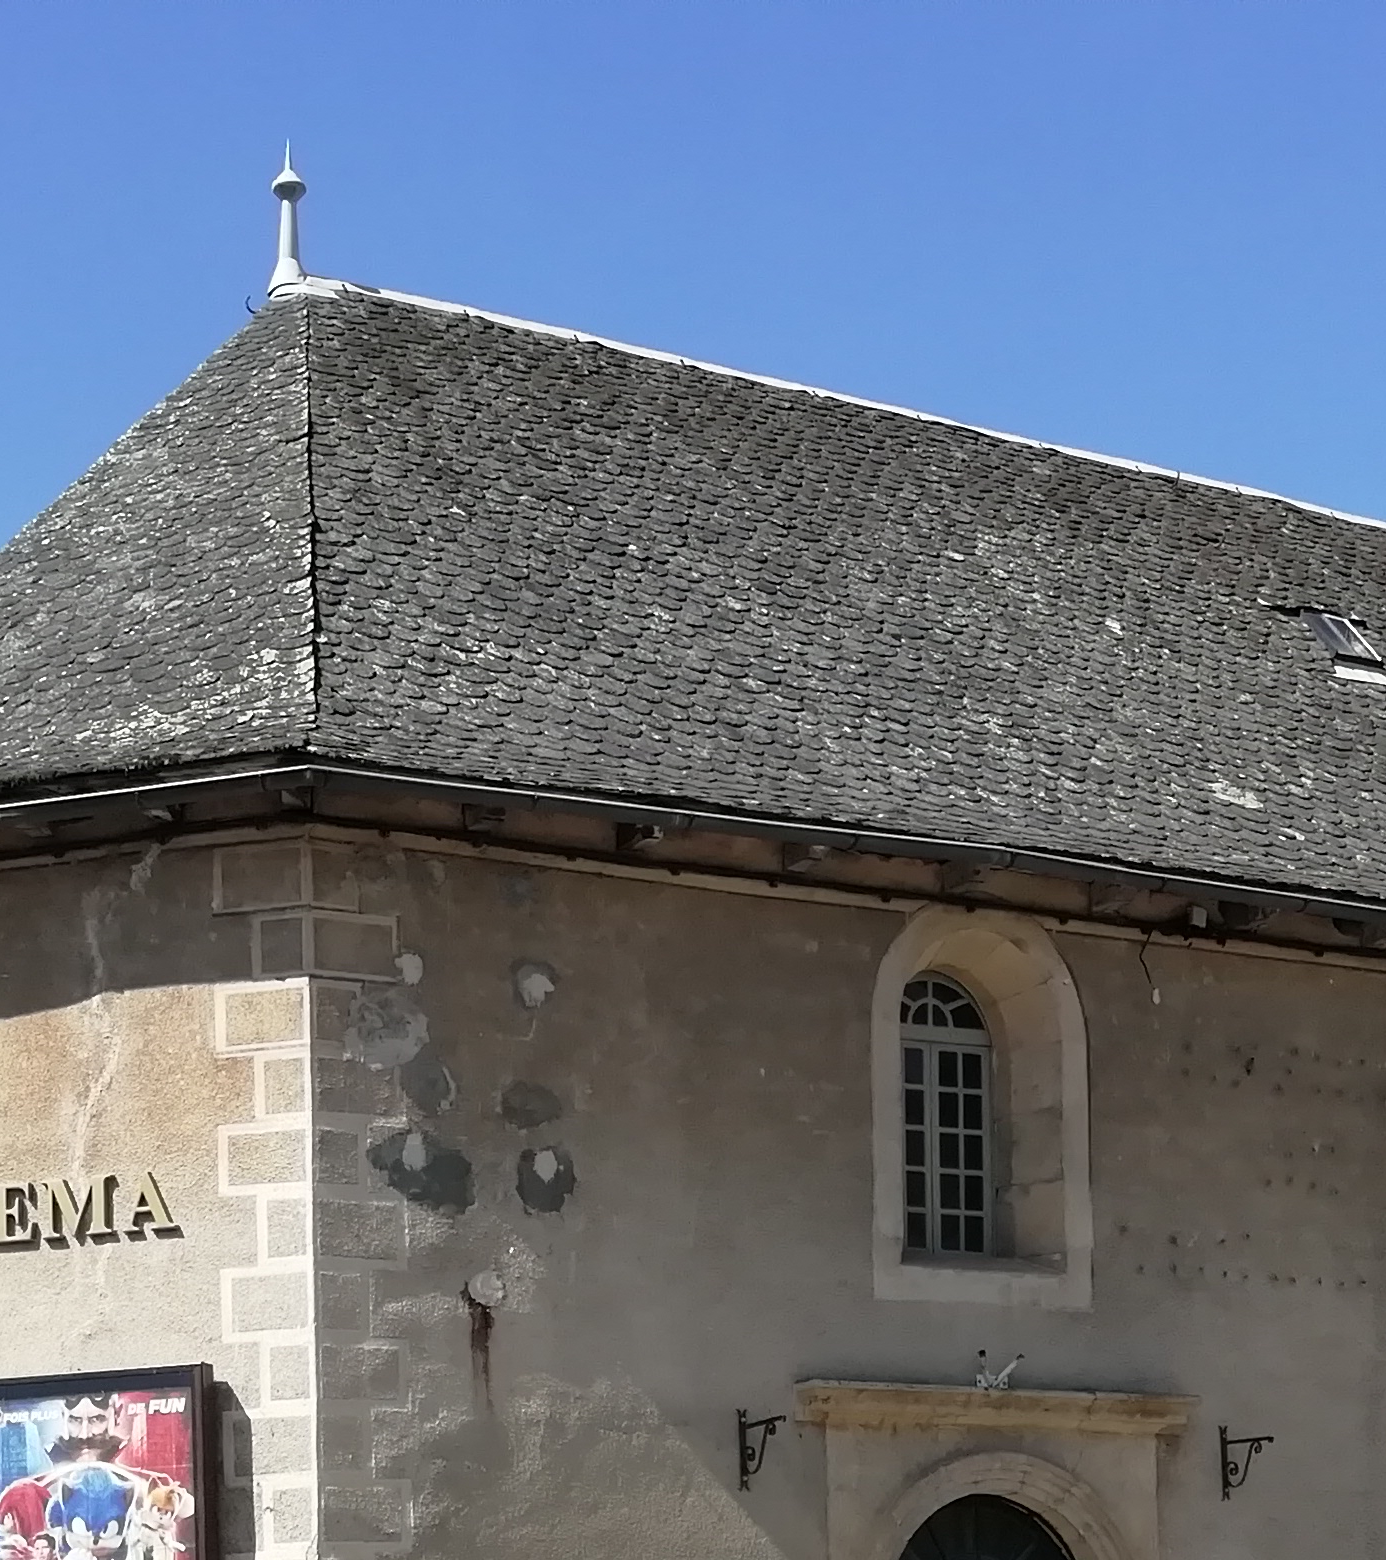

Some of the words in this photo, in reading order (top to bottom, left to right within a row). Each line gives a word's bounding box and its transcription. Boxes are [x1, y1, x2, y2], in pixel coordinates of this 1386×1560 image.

[4, 1410, 29, 1424] FOIS
[30, 1409, 60, 1421] PLUS
[128, 1403, 146, 1416] DE
[148, 1397, 187, 1415] FUN
